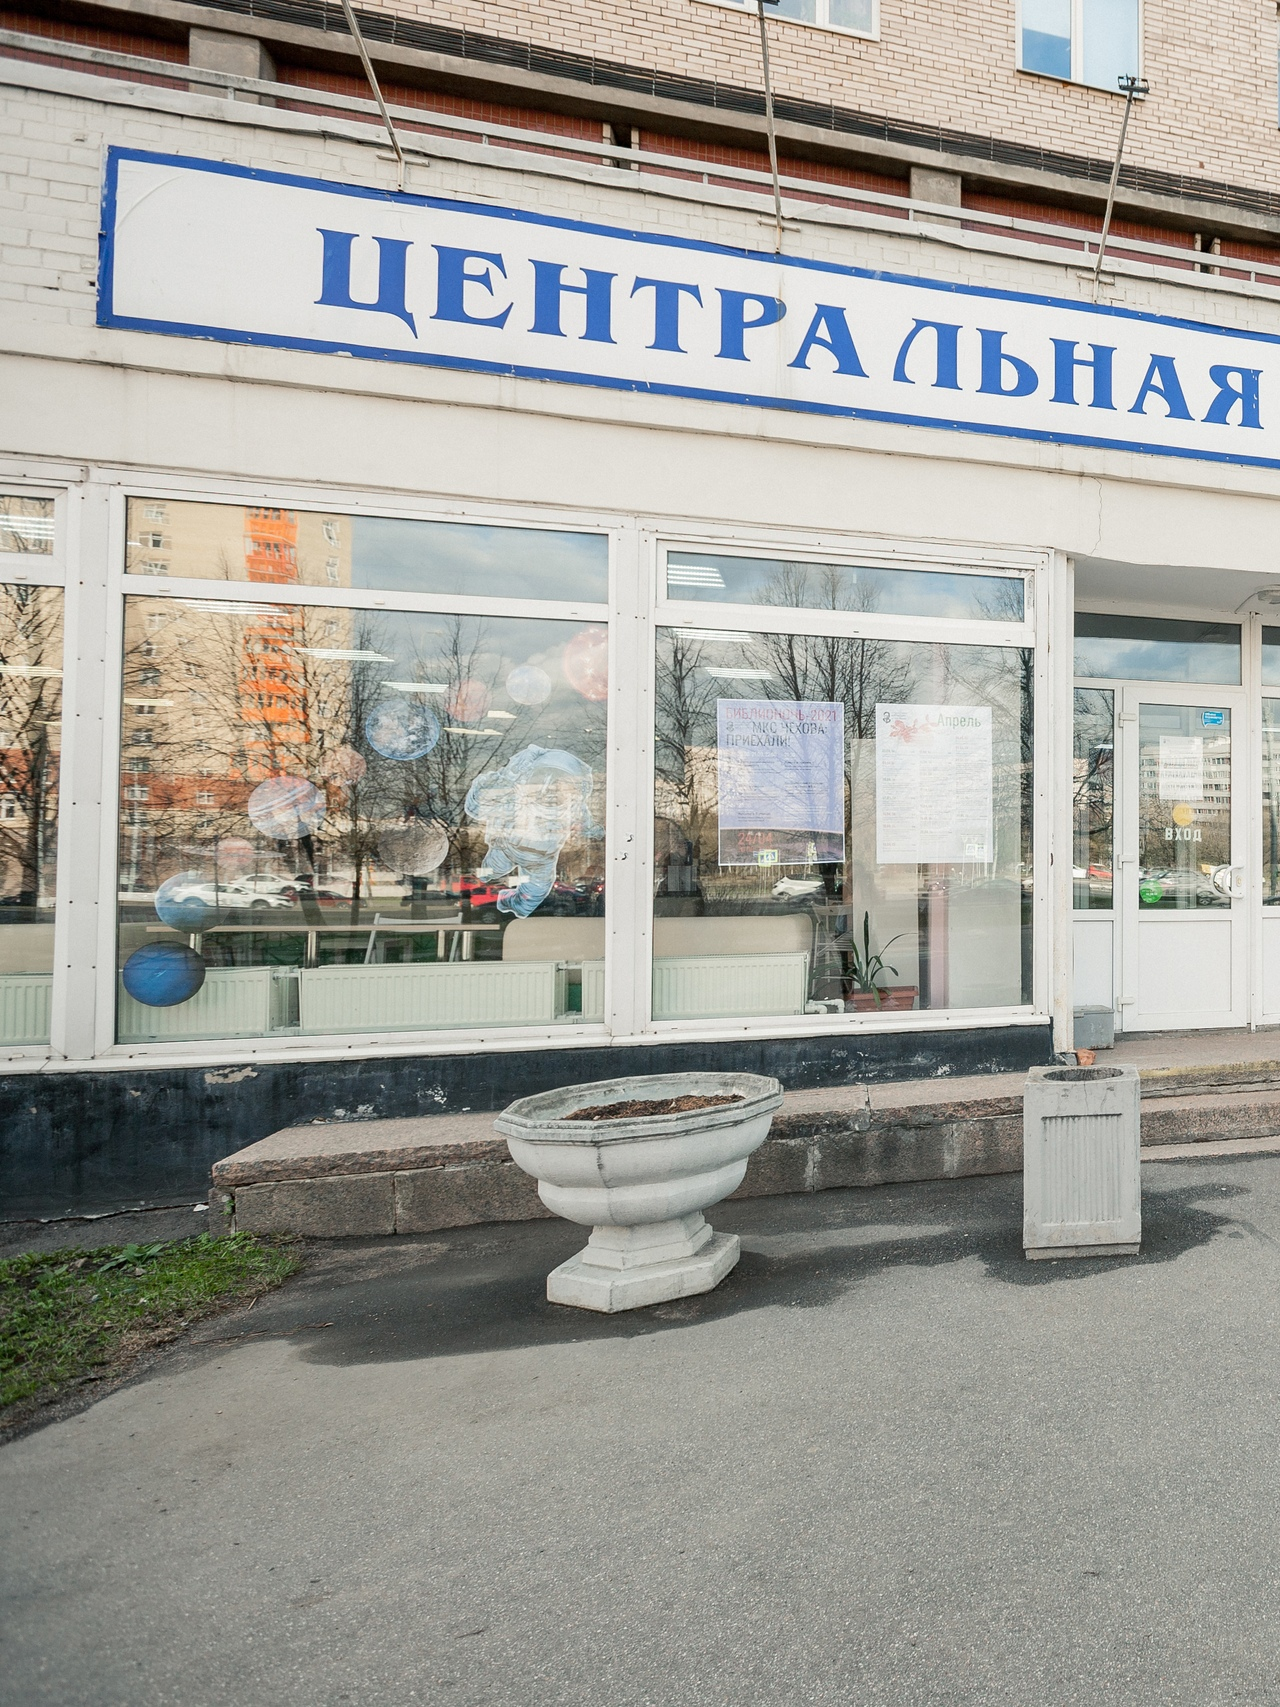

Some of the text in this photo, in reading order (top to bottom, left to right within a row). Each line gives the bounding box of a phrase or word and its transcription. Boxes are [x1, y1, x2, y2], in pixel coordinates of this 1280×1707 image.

[314, 228, 1264, 430] ЦЕНТРАЛЬНАЯ
[752, 721, 828, 735] МКС ЧЕХОВА:
[937, 713, 981, 729] Апрель
[726, 734, 791, 747] ПРИЕХАЛИ!
[1165, 828, 1202, 842] ВХОД
